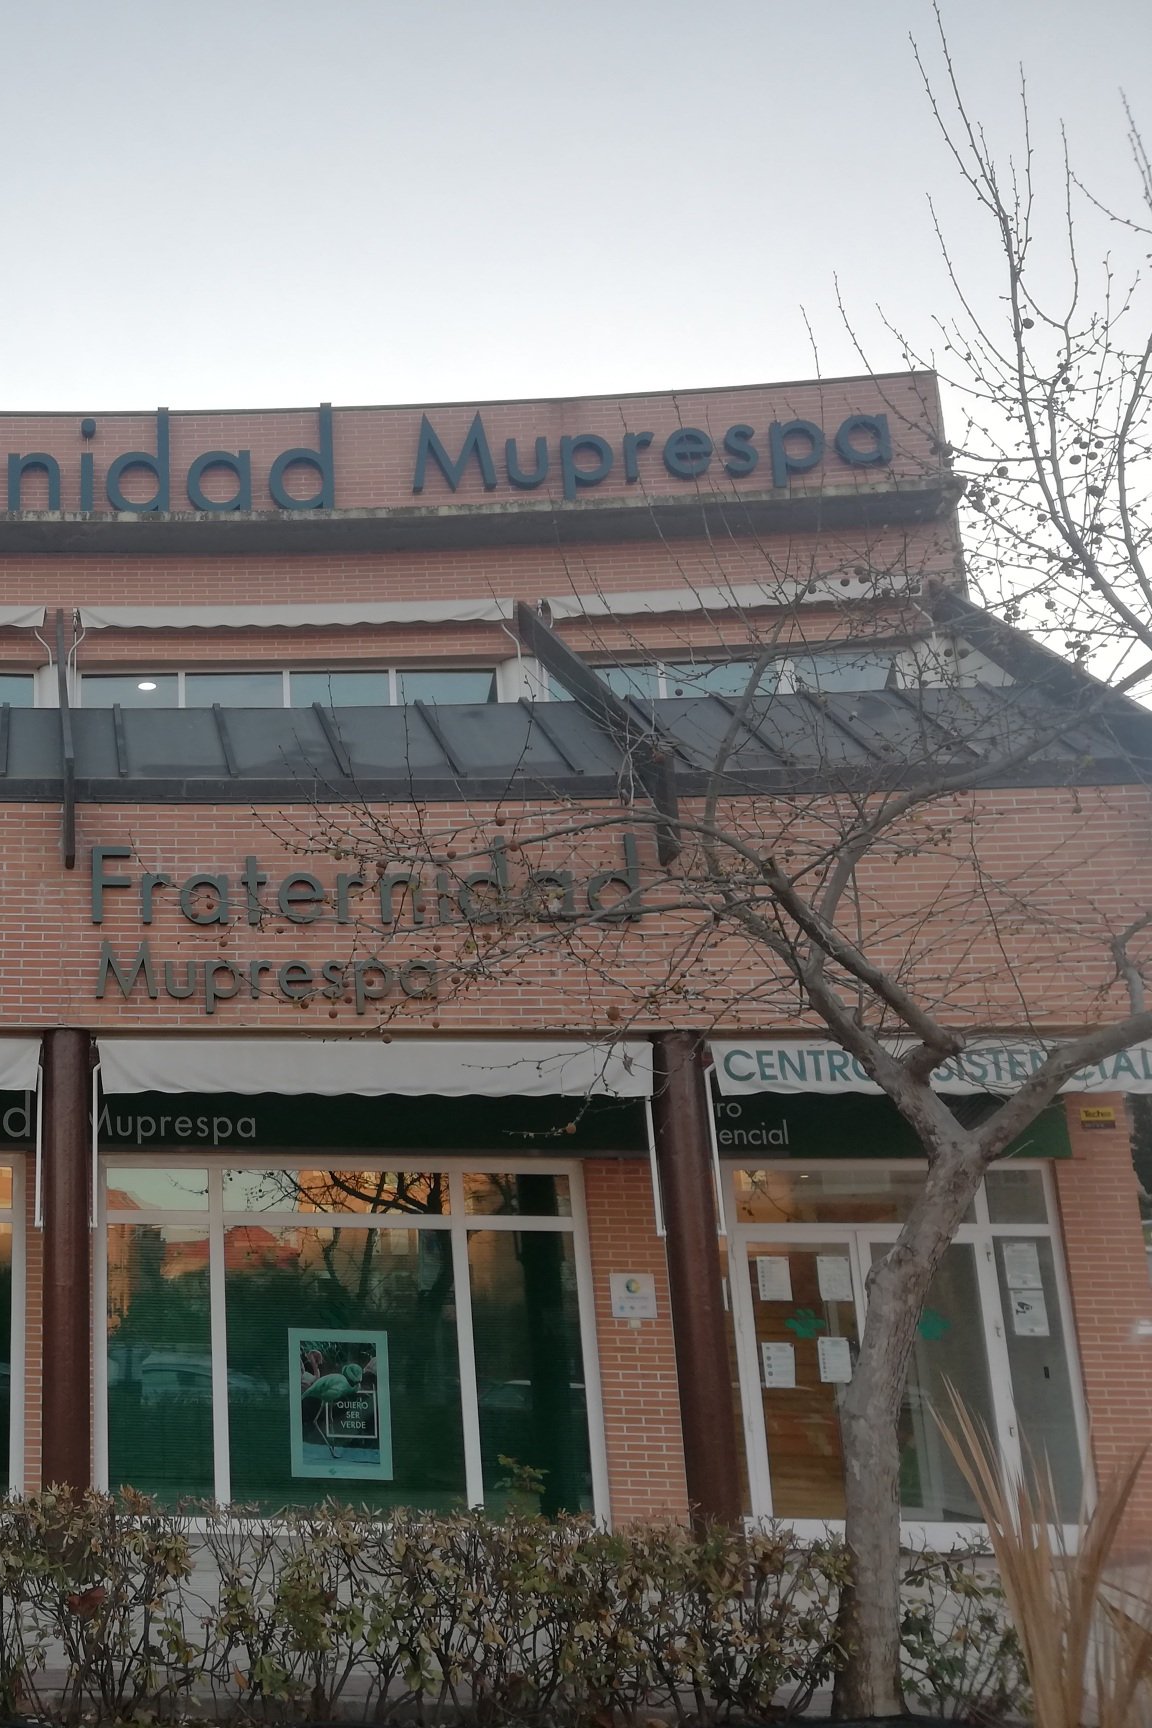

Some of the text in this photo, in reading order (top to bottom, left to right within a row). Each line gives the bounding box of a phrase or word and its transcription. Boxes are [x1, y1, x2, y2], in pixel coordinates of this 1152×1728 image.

[413, 410, 892, 500] Muprespa
[92, 834, 642, 925] Fraternidad
[95, 940, 438, 1014] Muprespa
[713, 1102, 742, 1118] ro
[89, 1103, 256, 1145] Muprespa
[718, 1119, 789, 1145] encial
[337, 1401, 369, 1410] QUIERO
[346, 1411, 360, 1419] SER
[340, 1420, 366, 1429] VERDE
